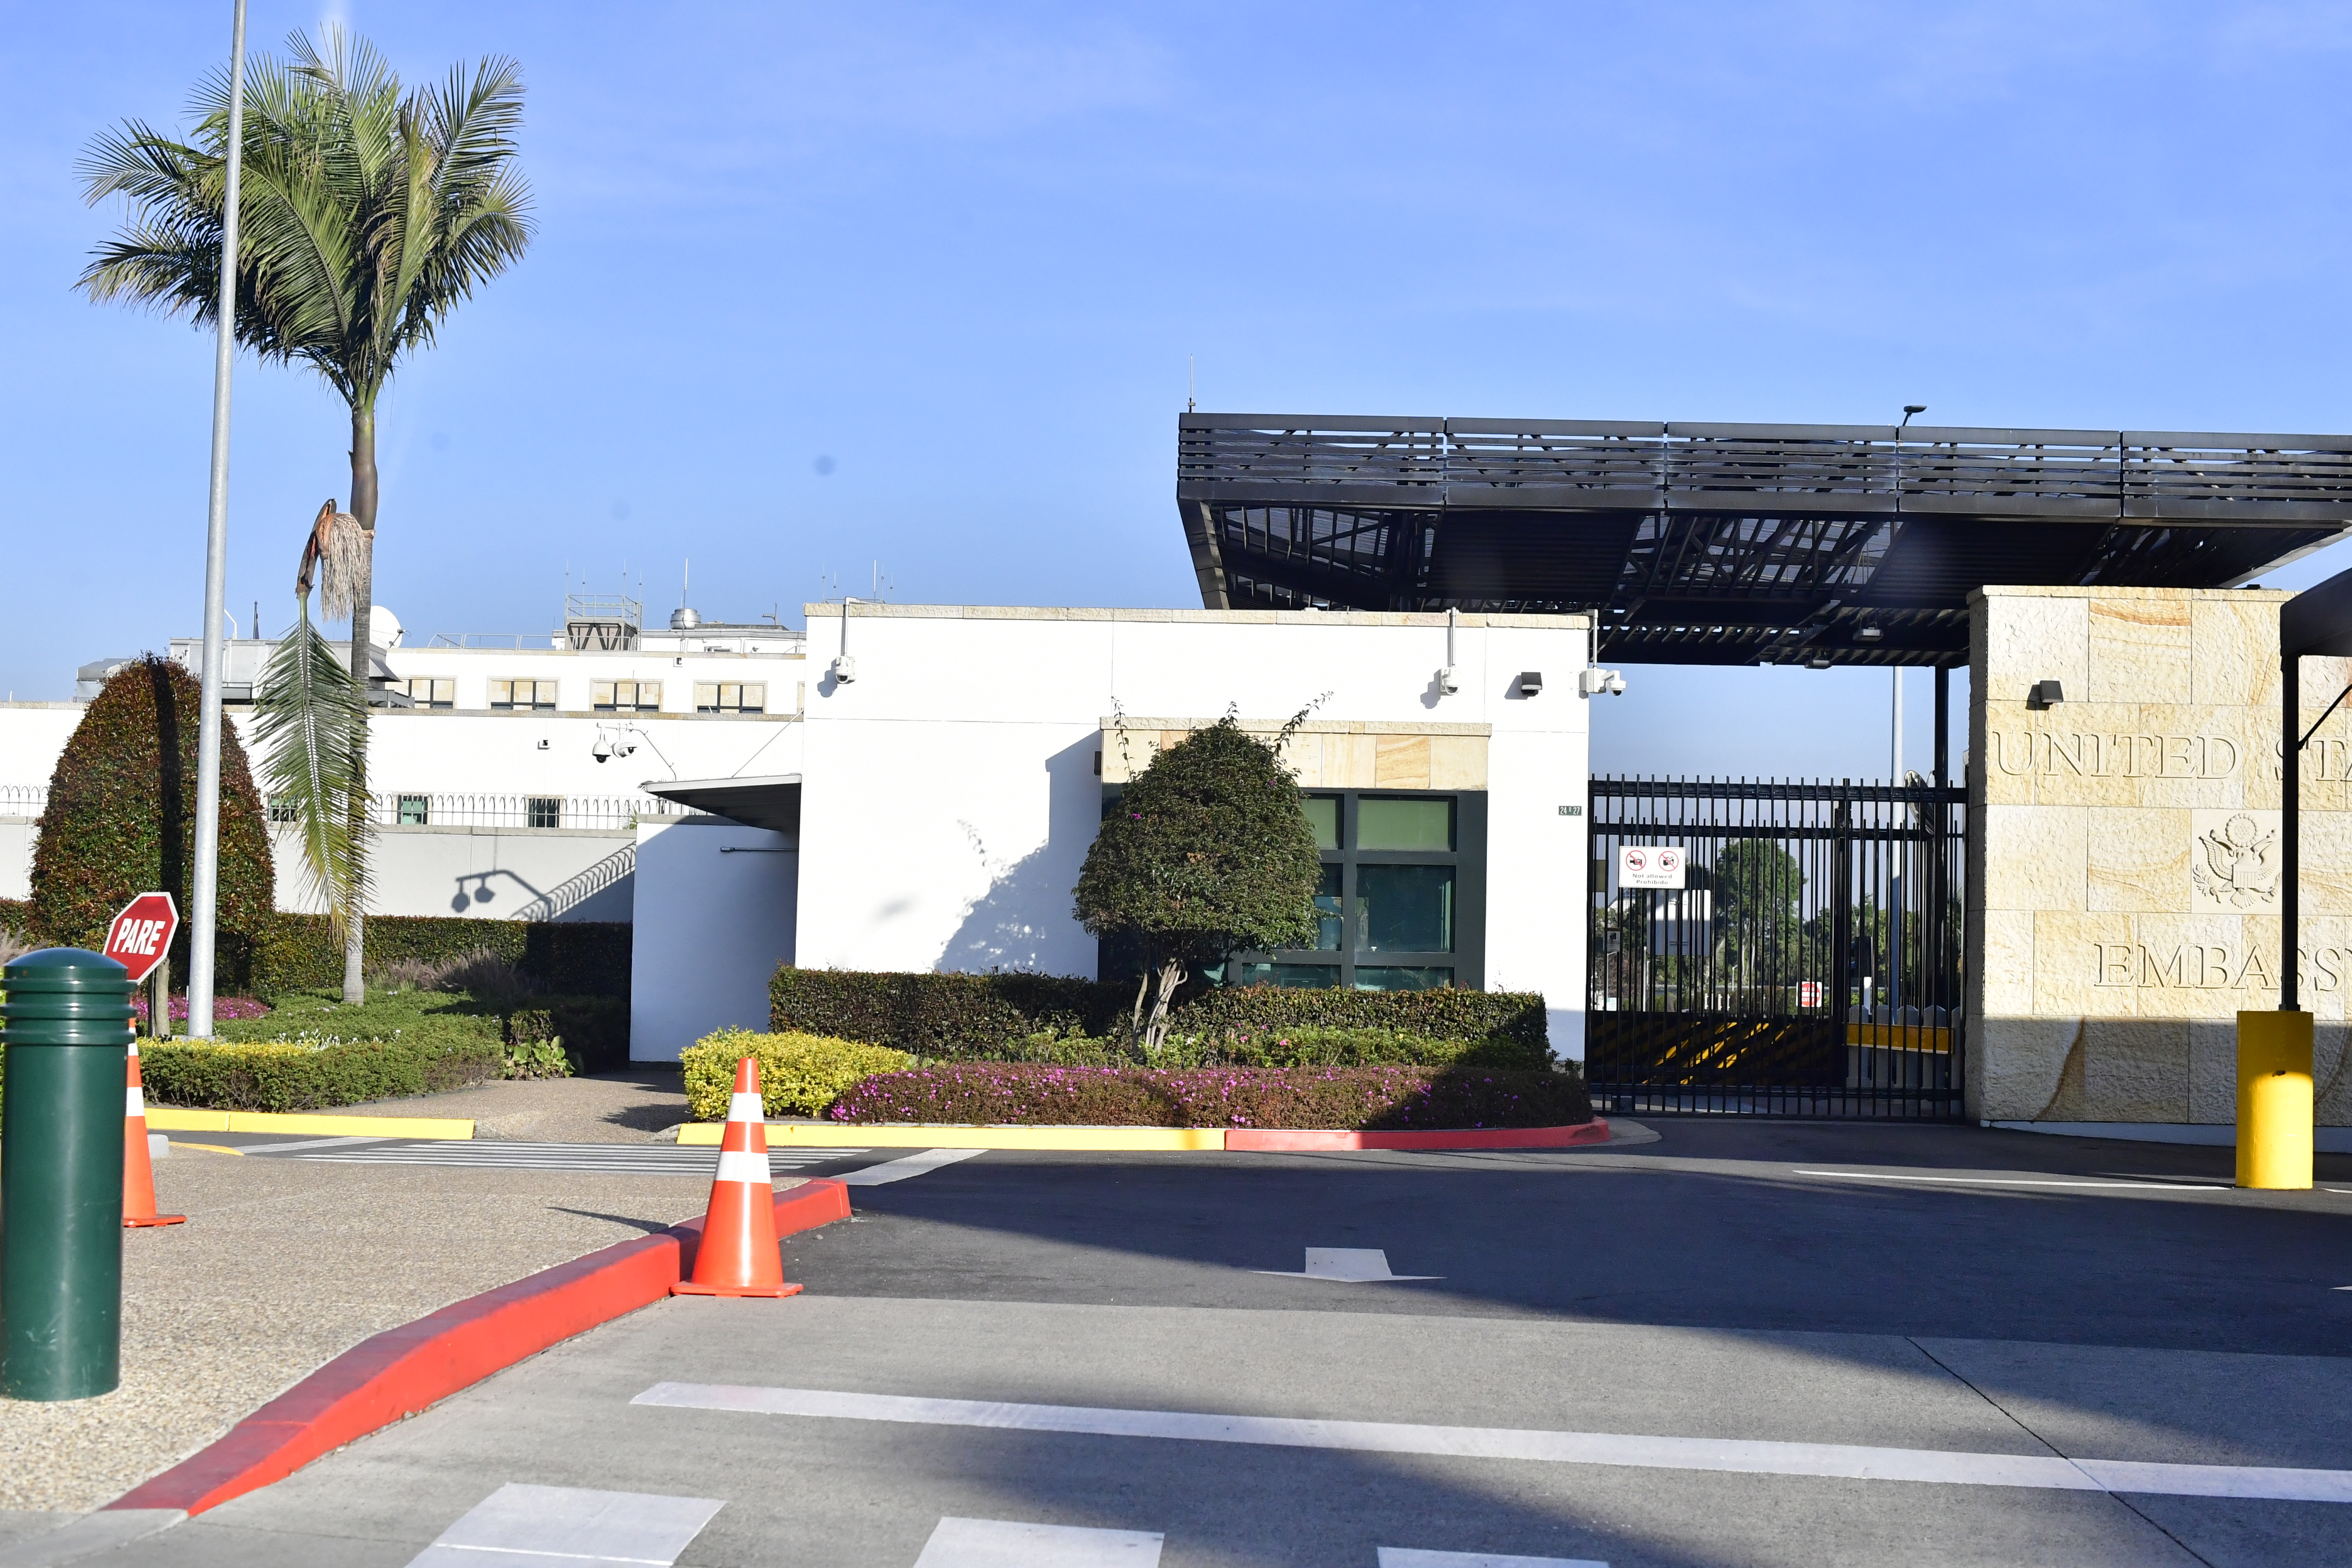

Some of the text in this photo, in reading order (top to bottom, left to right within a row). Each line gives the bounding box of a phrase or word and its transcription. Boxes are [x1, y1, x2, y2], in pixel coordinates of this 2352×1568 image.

[1992, 731, 2352, 782] UNITED ST
[1573, 807, 1580, 815] 27
[112, 918, 166, 955] PARE
[2093, 941, 2352, 992] EMBAS
